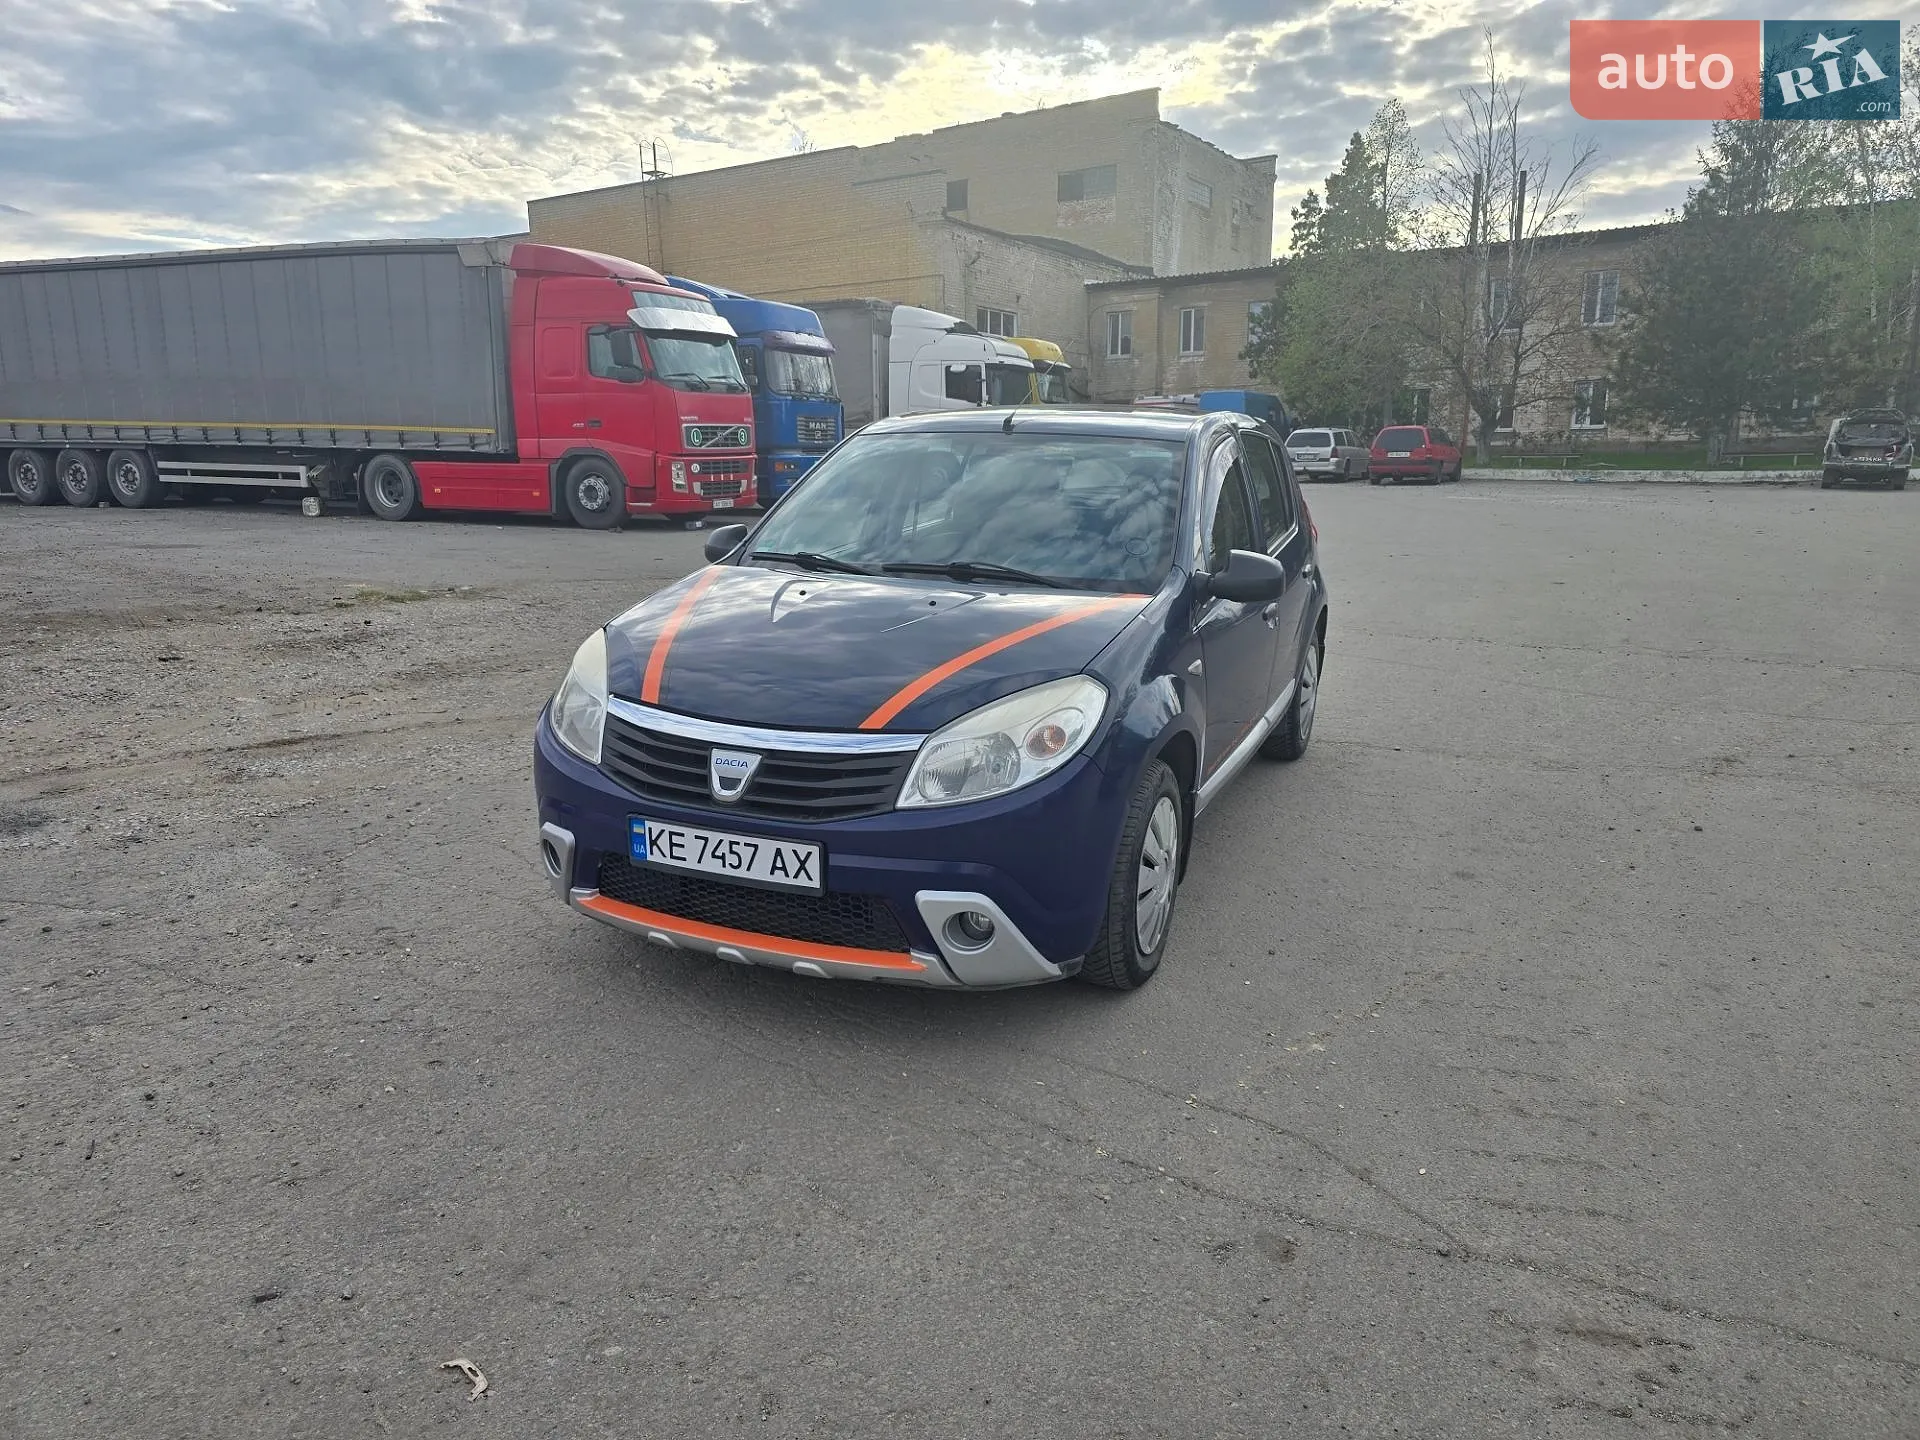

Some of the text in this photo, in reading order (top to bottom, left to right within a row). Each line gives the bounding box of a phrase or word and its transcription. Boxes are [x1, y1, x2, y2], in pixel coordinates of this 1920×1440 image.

[809, 421, 827, 430] MAN
[715, 757, 749, 769] DACIA
[633, 843, 646, 854] UA
[648, 826, 814, 881] KE 7457 AX
